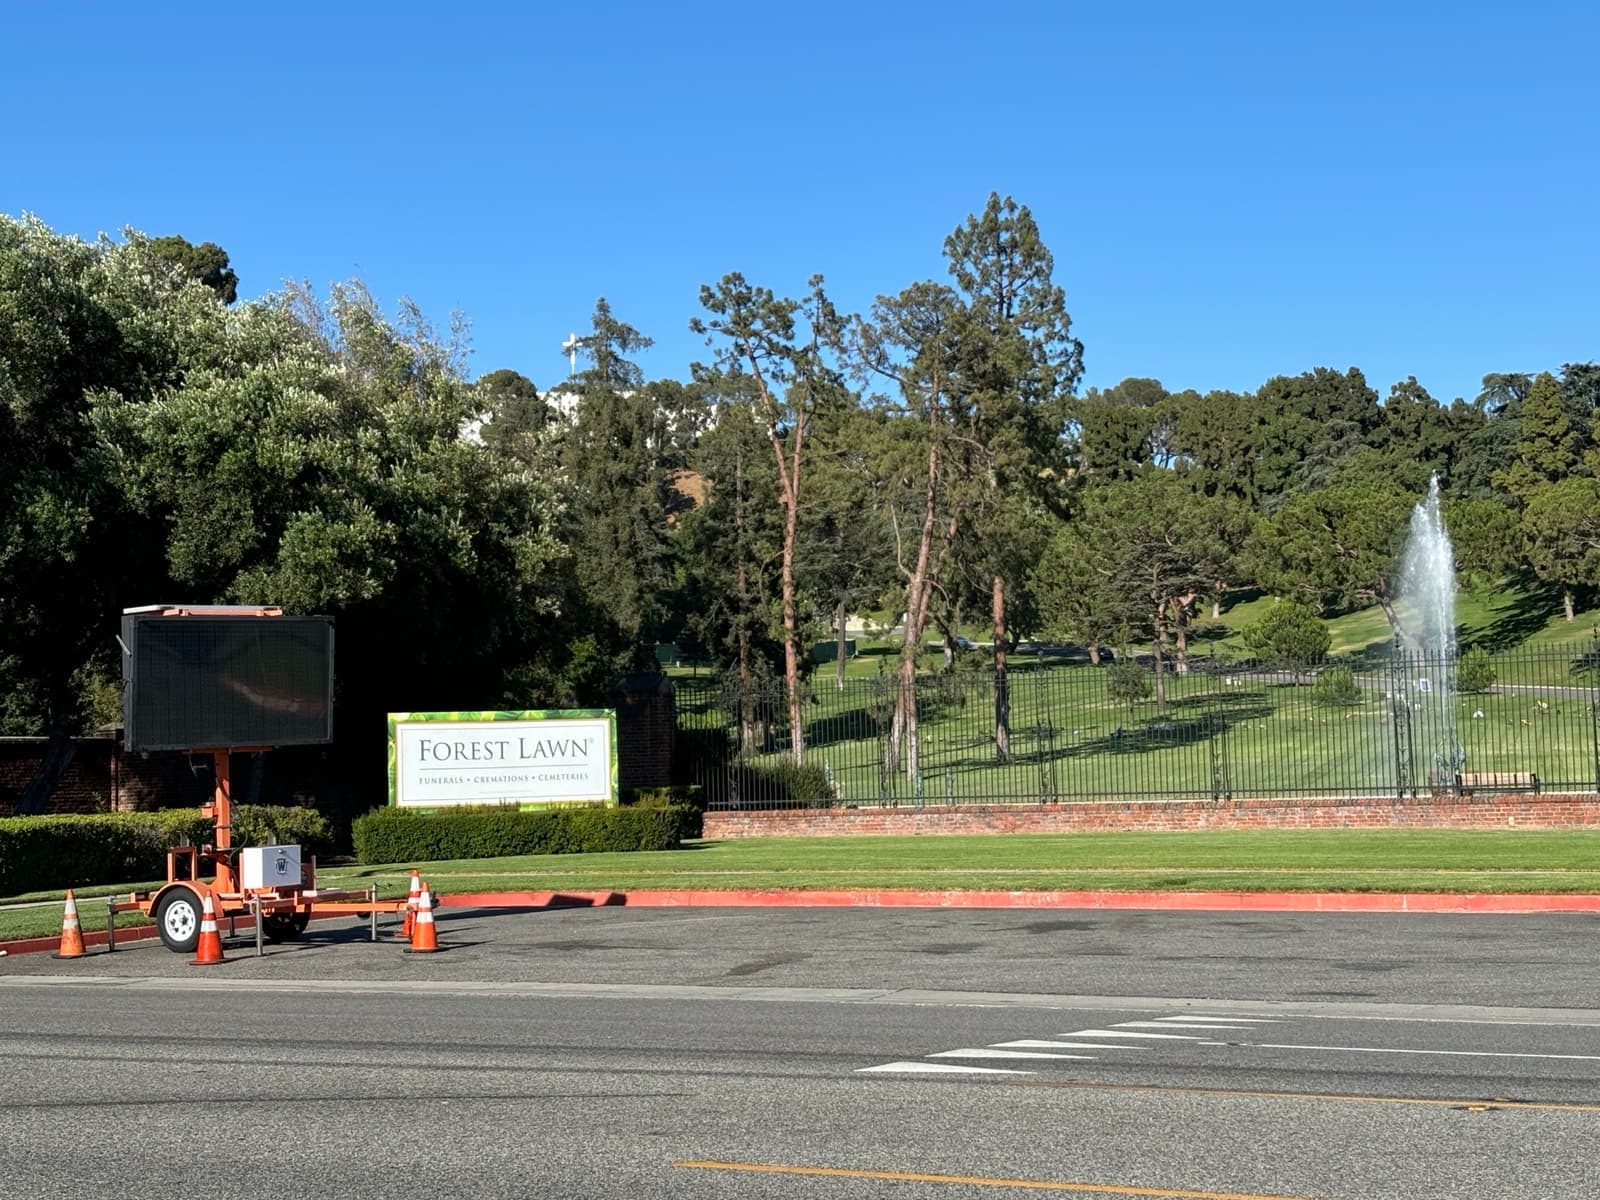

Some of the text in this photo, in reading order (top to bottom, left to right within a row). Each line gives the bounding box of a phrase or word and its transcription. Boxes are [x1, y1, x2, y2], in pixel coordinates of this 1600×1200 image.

[419, 737, 588, 761] FOREST LAWN
[419, 772, 589, 785] FUNERALS CREMATIONS CEMETERIES
